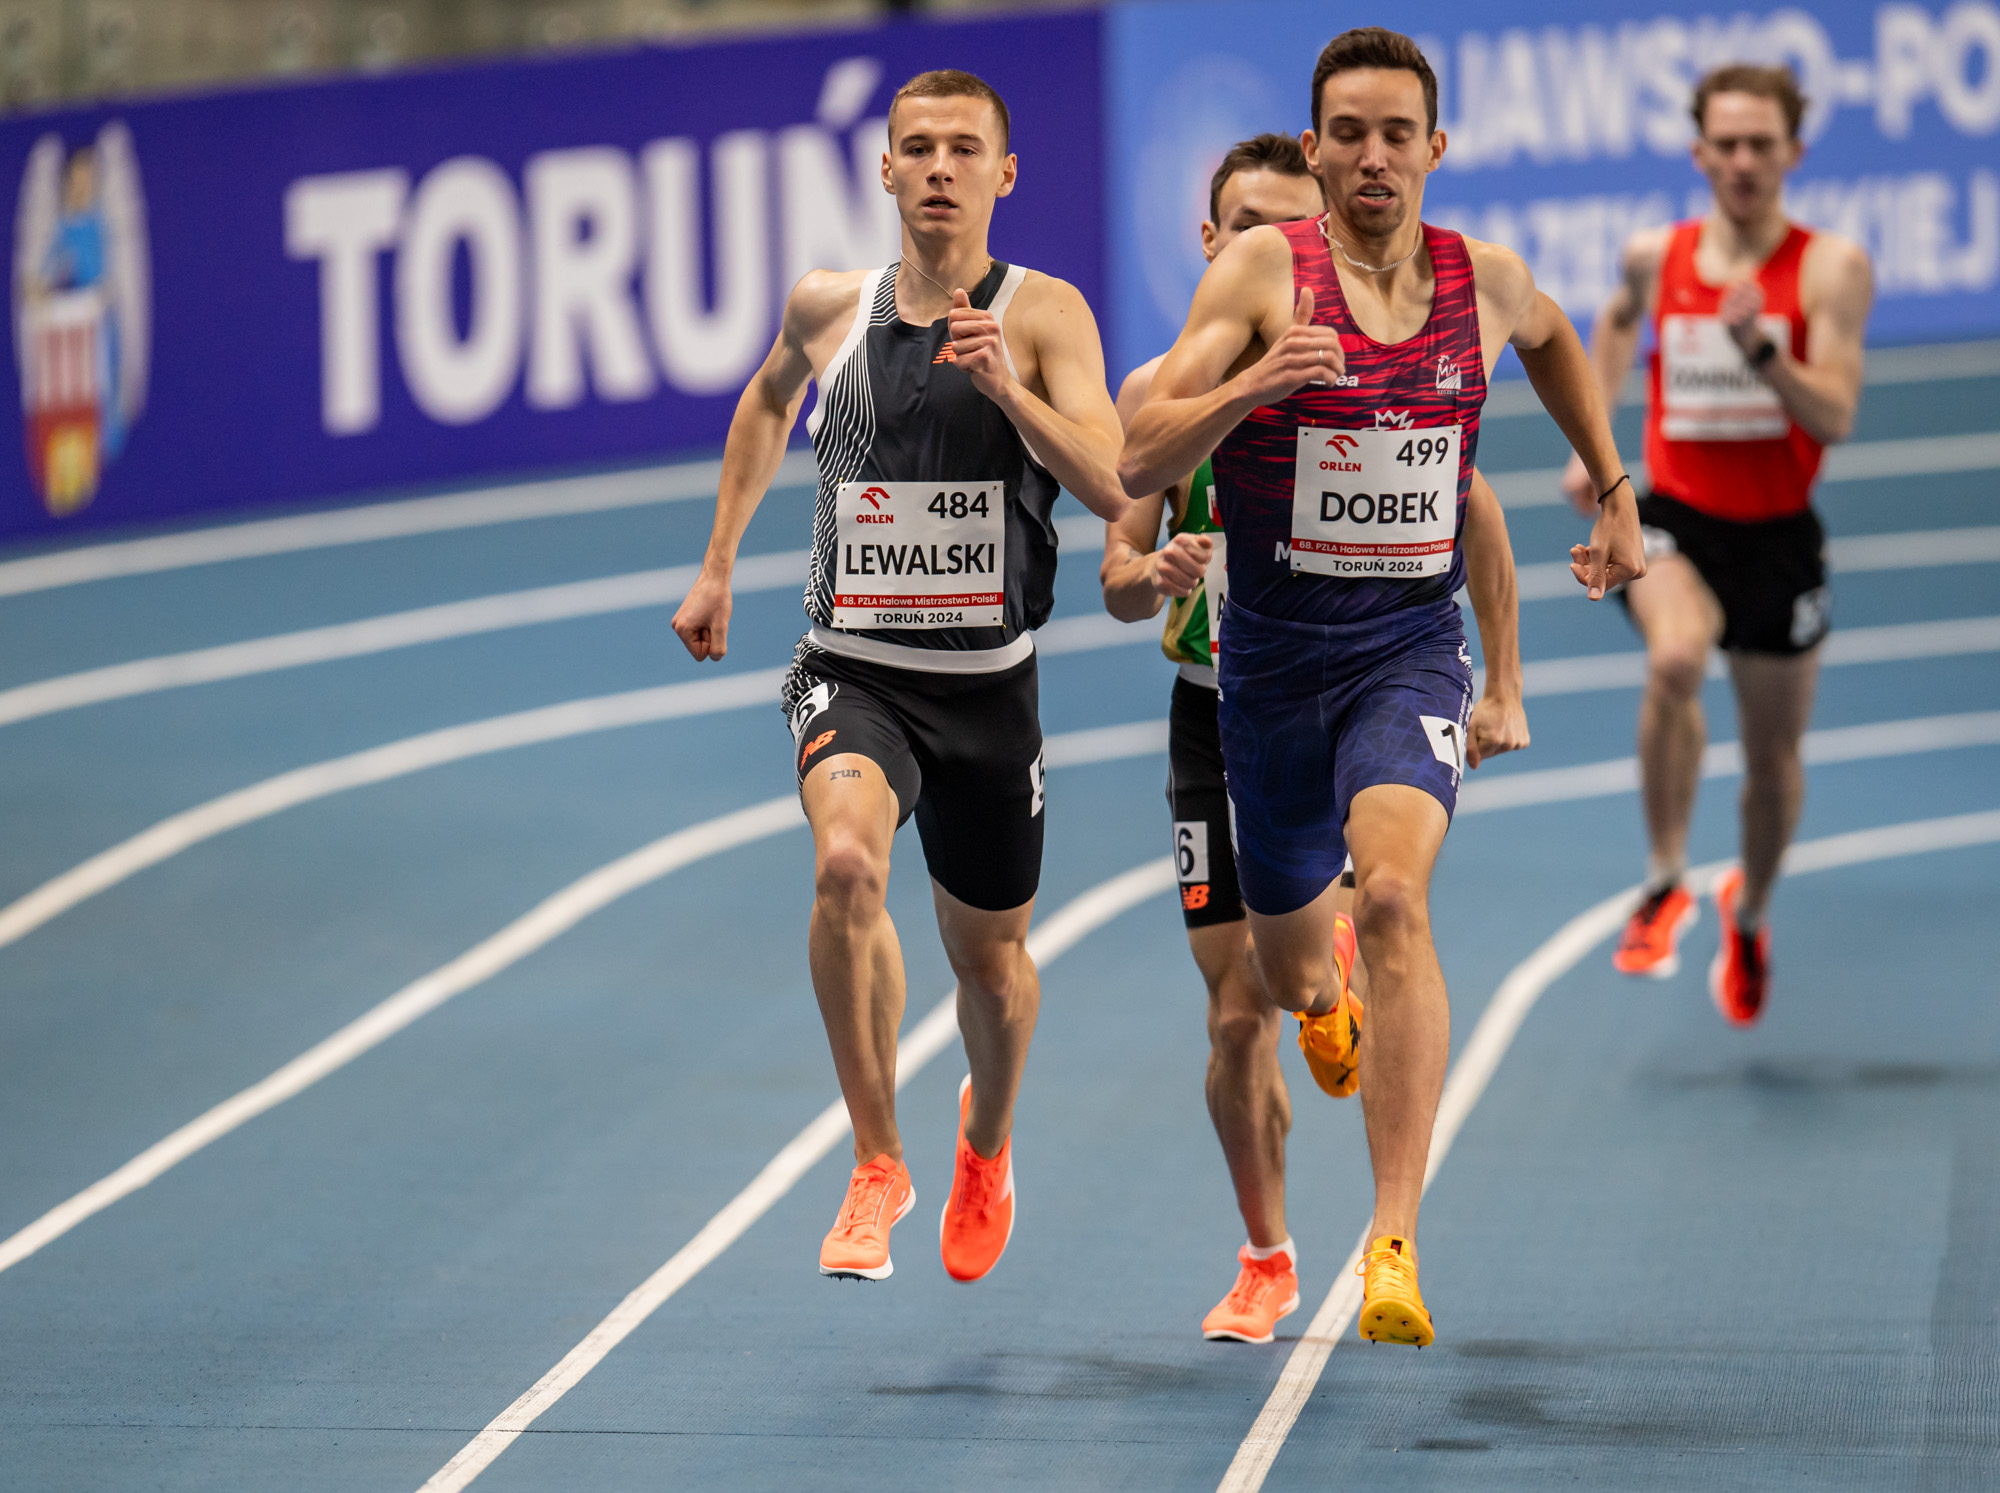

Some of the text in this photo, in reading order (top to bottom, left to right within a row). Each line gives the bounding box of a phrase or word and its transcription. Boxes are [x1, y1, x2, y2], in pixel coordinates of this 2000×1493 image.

[1424, 5, 2000, 170] JAWSO-PO
[284, 56, 901, 437] TORUŃ
[1396, 436, 1449, 467] 499
[1319, 460, 1362, 473] ORLEN
[856, 514, 894, 524] ORLEN
[927, 491, 989, 519] 484
[1319, 490, 1440, 524] DOBEK
[845, 543, 996, 575] LEWALSKI
[1299, 540, 1451, 555] 68. PZLA Halowe Mistrzostwa Polski
[1333, 558, 1424, 573] TORUŃ 2024
[842, 594, 998, 607] 68. PZLA Halowe Mistrzostwa Polski
[874, 610, 964, 625] TORUŃ 2024
[1440, 723, 1460, 768] 1
[830, 769, 862, 781] run
[1178, 826, 1195, 877] 6
